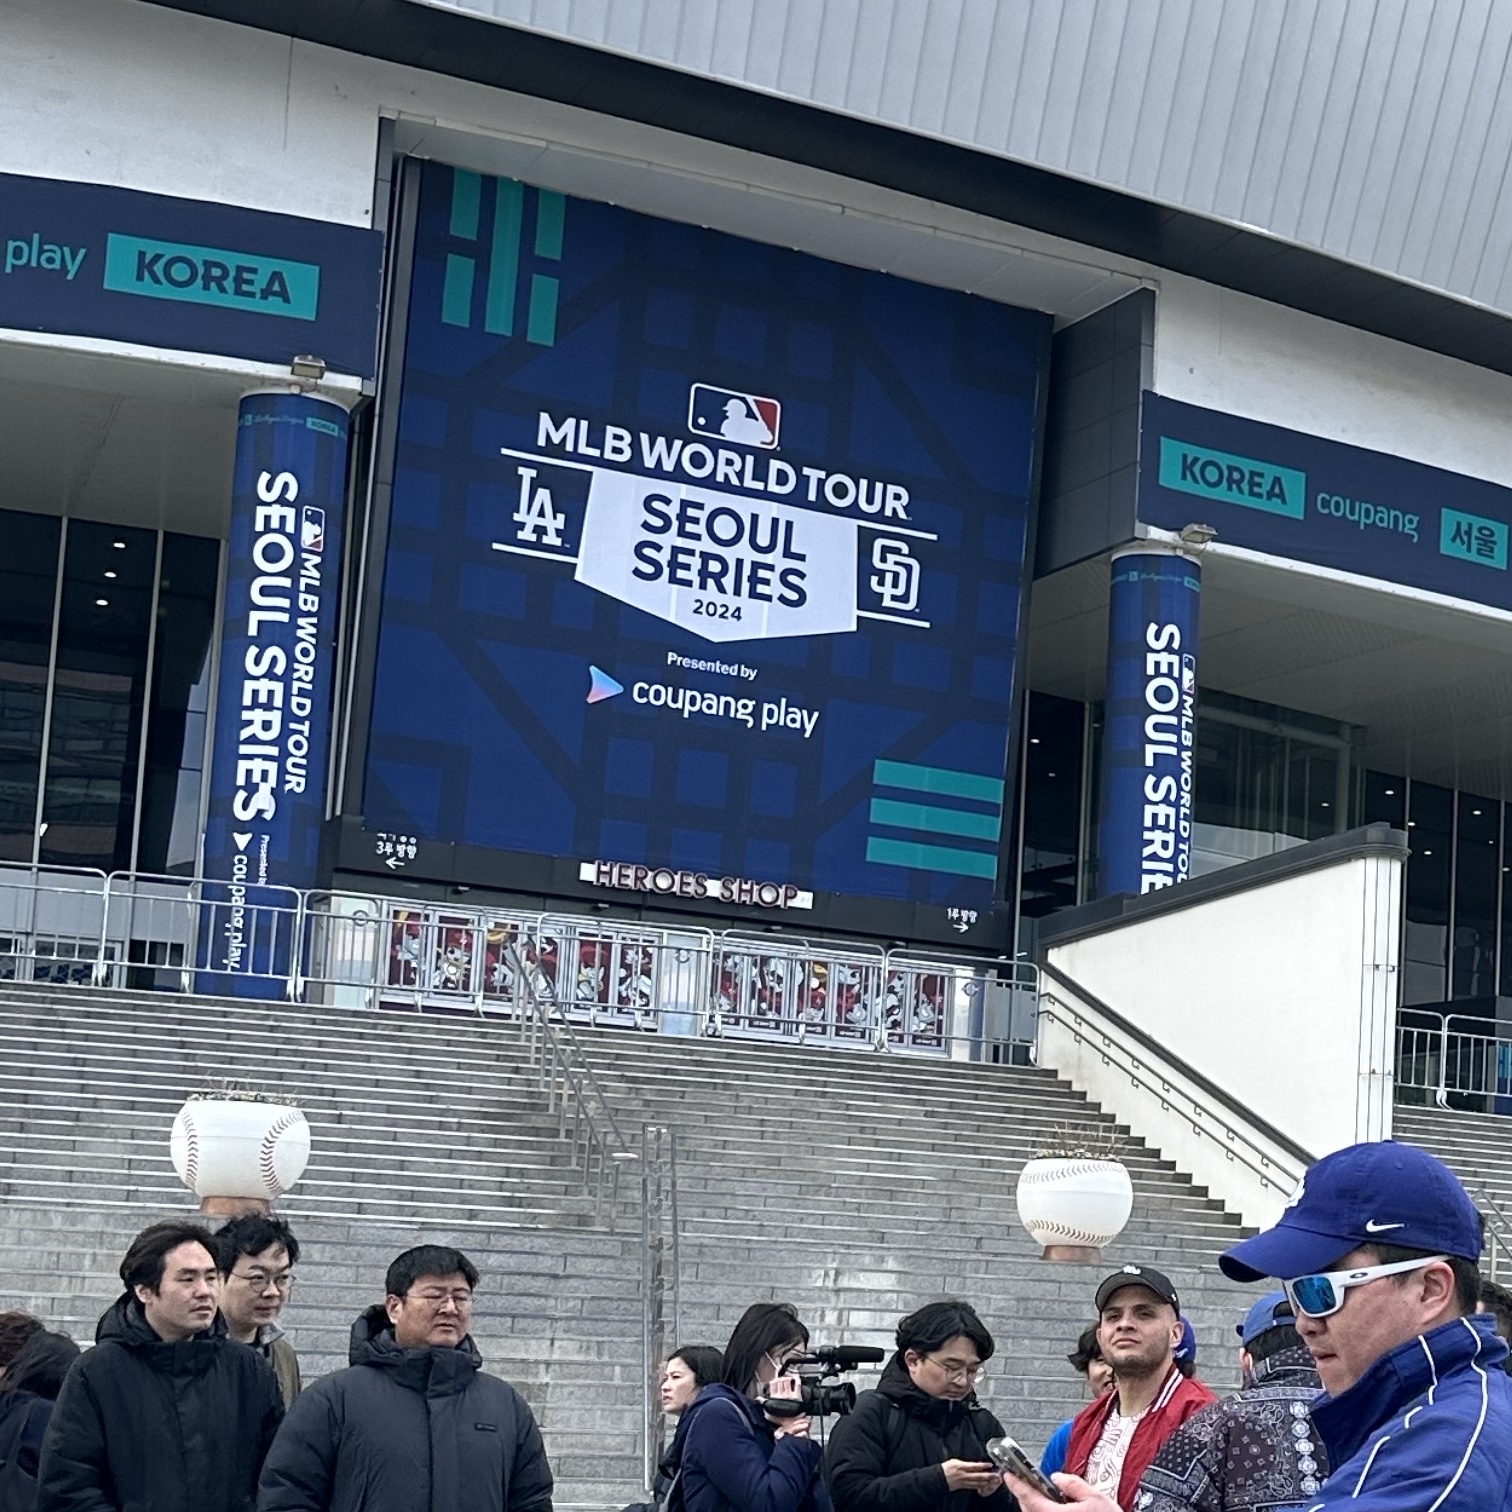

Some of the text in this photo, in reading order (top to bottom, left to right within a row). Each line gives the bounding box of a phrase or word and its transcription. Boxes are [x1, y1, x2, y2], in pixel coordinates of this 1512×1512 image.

[5, 233, 292, 305] play KOREA
[537, 411, 911, 521] MLB WORLD TOUR
[640, 492, 808, 563] SEOUL
[1180, 452, 1288, 506] KOREA
[1316, 492, 1420, 543] coupang
[1450, 519, 1498, 561] 서울
[247, 470, 299, 636] SEOUL
[631, 540, 808, 609] SERIES
[692, 598, 743, 623] 2024
[283, 552, 322, 794] MLB WORLD TOUR
[666, 651, 759, 681] Presented by
[1144, 621, 1182, 768] SEOUL
[232, 645, 288, 822] SERIES
[631, 680, 820, 738] coupang play
[1181, 694, 1195, 748] MLB
[1179, 749, 1194, 840] WORLD
[593, 859, 800, 910] HEROES SHOP
